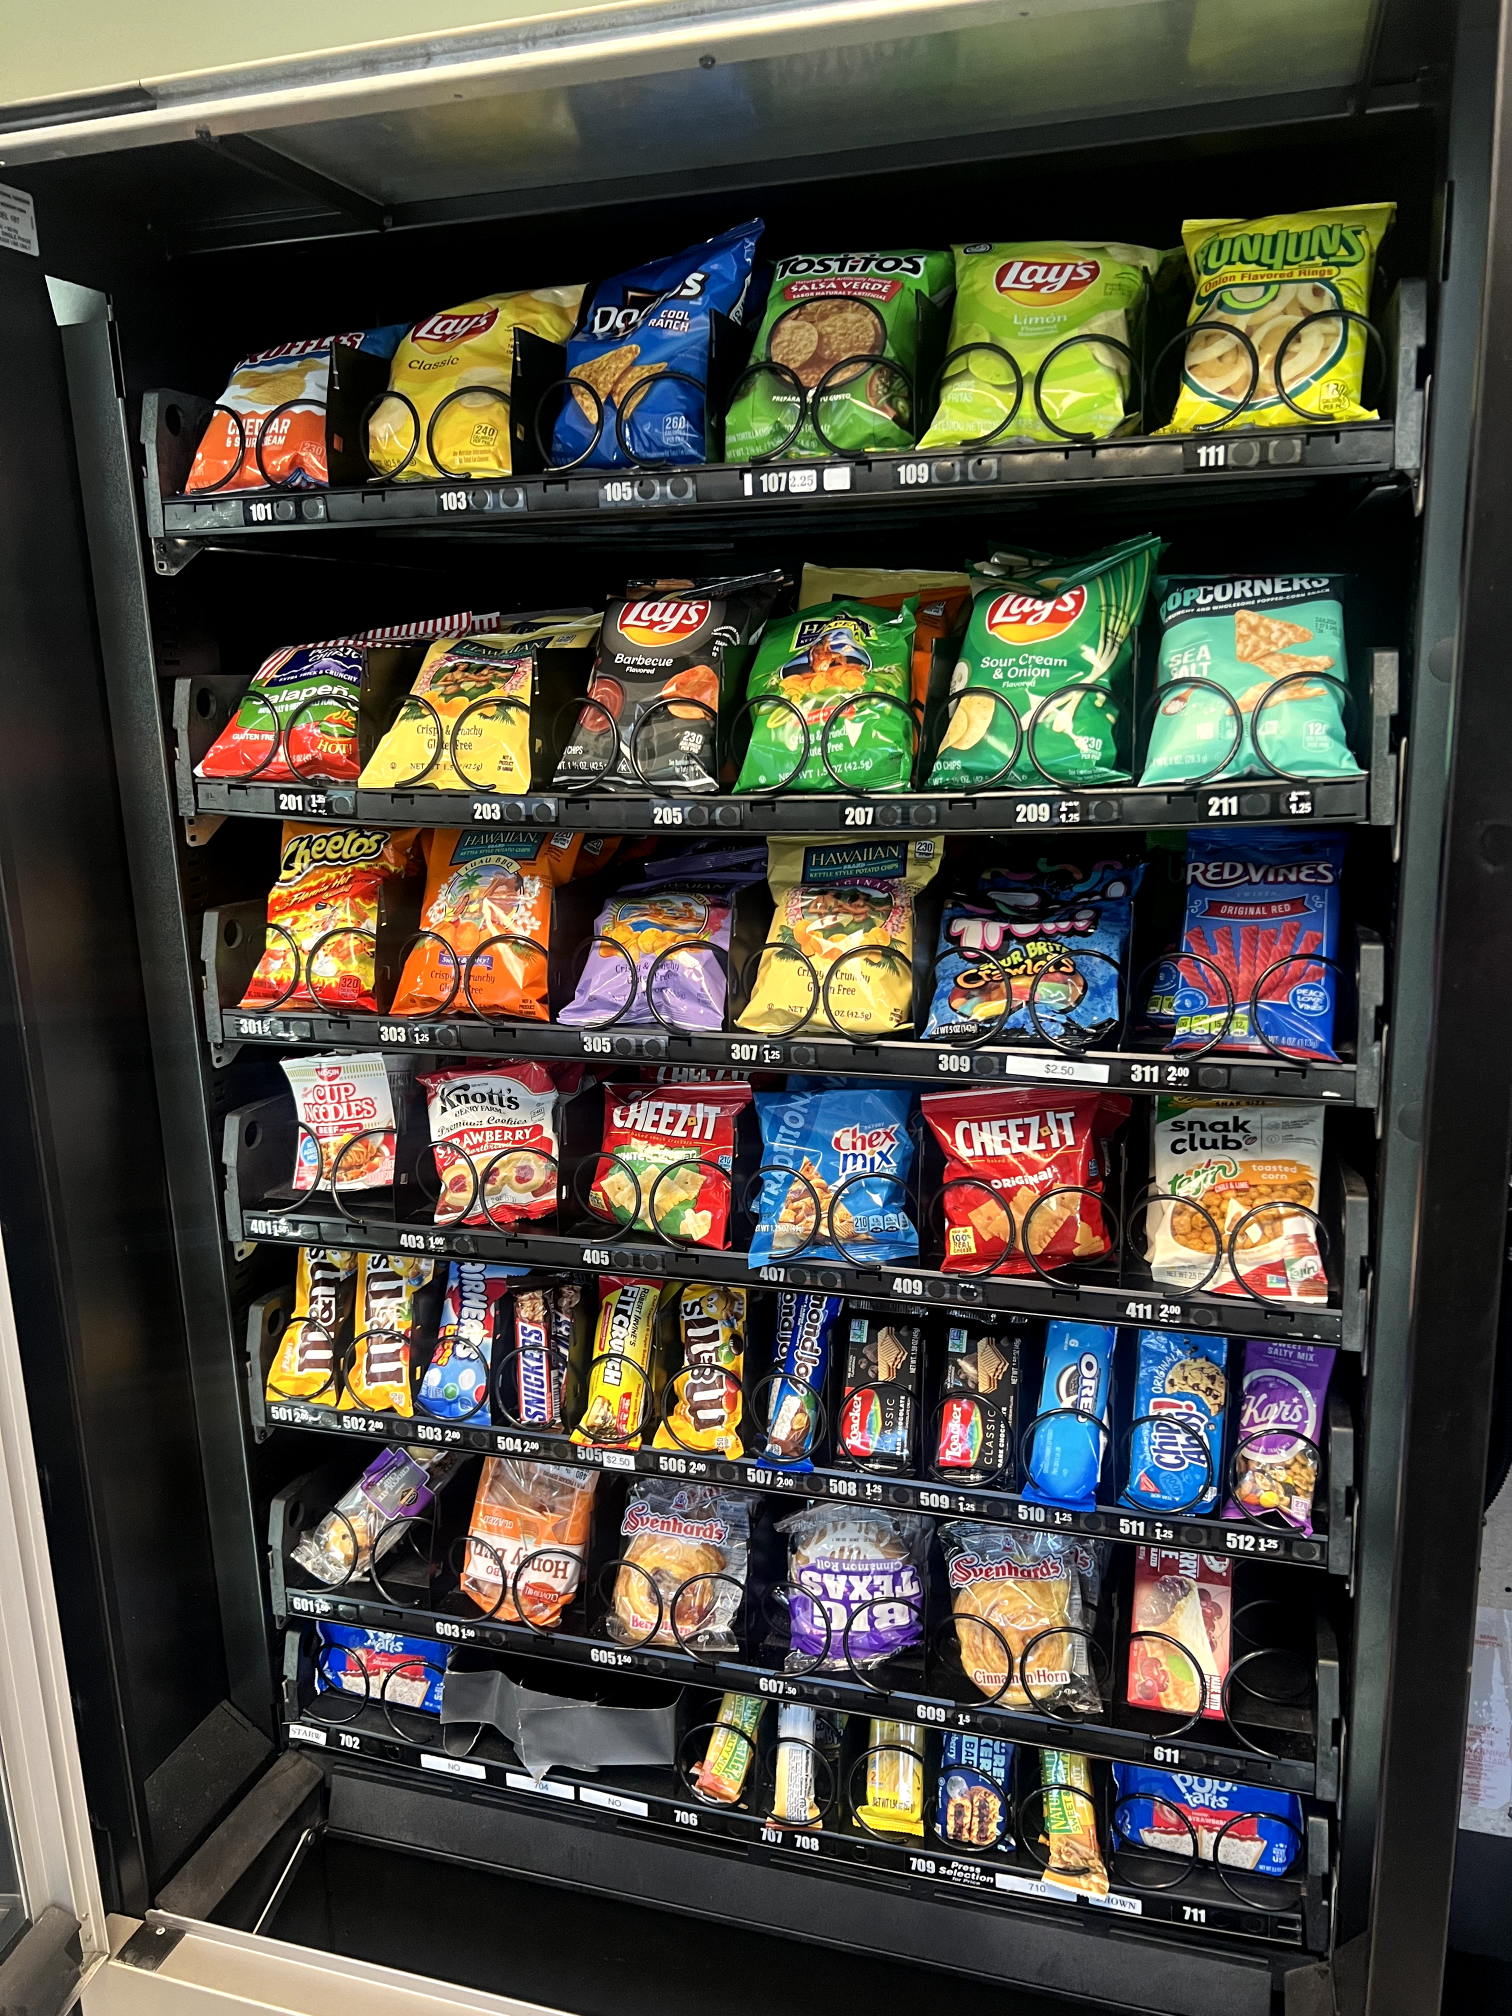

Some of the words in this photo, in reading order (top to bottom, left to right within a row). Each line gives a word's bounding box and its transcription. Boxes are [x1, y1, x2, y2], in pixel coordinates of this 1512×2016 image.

[1000, 261, 1096, 293] Lay's
[1205, 274, 1236, 293] Onion
[1240, 270, 1294, 281] Flavored
[1298, 267, 1333, 278] Rings
[791, 281, 836, 292] SALSA
[843, 281, 891, 292] VERDE
[660, 310, 690, 321] COOL
[1013, 313, 1067, 324] Limón
[416, 313, 492, 342] Lay's
[648, 318, 690, 332] RANCH
[408, 355, 459, 371] Classic
[475, 426, 495, 437] 240
[1197, 445, 1225, 467] 111
[898, 463, 929, 484] 109
[760, 473, 787, 492] 107
[789, 474, 814, 488] 2.25
[604, 482, 632, 501] 105
[440, 491, 467, 510] 103
[250, 503, 272, 521] 101
[614, 653, 673, 667] Barbecue
[981, 657, 1015, 668] Sour
[1019, 654, 1067, 667] Cream
[1169, 645, 1211, 667] SEA
[325, 669, 358, 682] CRUNCHY
[993, 669, 1004, 679] &
[1007, 666, 1050, 678] Onion
[682, 731, 703, 744] 230
[317, 739, 352, 754] HOT!
[280, 794, 303, 810] 201
[1208, 796, 1238, 816] 211
[1290, 803, 1312, 814] 1.25
[473, 803, 500, 820] 203
[653, 807, 682, 825] 205
[845, 807, 873, 825] 207
[1016, 804, 1050, 823] 209
[464, 832, 537, 846] HAWAIIAN
[916, 842, 933, 852] 230
[279, 829, 389, 881] Cheetos
[811, 845, 899, 866] HAWAIIAN
[464, 857, 492, 872] LUAU
[496, 857, 513, 869] BBQ
[881, 863, 898, 871] CHIPS
[1221, 905, 1267, 915] ORIGINAL
[1272, 904, 1291, 913] RED
[341, 978, 358, 988] 320
[837, 985, 856, 995] Free
[1296, 989, 1324, 997] PEACE
[1297, 1003, 1324, 1011] VINES
[240, 1019, 262, 1034] 301
[380, 1026, 406, 1042] 303
[583, 1037, 611, 1053] 305
[731, 1044, 757, 1060] 307
[938, 1055, 970, 1072] 309
[1044, 1065, 1074, 1076] $2.50
[1131, 1064, 1159, 1082] 311
[1167, 1066, 1189, 1082] 2.00
[313, 1083, 356, 1104] CUP
[440, 1083, 520, 1116] Knott's
[304, 1097, 376, 1124] NOODLES
[481, 1105, 502, 1113] FARM
[318, 1126, 339, 1134] BEEF
[437, 1119, 484, 1137] Premium
[487, 1116, 528, 1125] Cookies
[1169, 1116, 1252, 1133] snak
[832, 1123, 900, 1151] Chex
[1170, 1134, 1243, 1154] club
[840, 1144, 896, 1175] mix
[1251, 1164, 1298, 1173] toasted
[1215, 1184, 1228, 1193] CHILI
[250, 1220, 272, 1234] 401
[855, 1216, 868, 1228] 210
[400, 1234, 424, 1248] 403
[583, 1250, 609, 1265] 405
[760, 1267, 785, 1282] 407
[892, 1278, 922, 1295] 409
[635, 1288, 650, 1313] ROBERT
[1126, 1302, 1151, 1319] 411
[1159, 1305, 1180, 1317] 2.00
[1267, 1347, 1294, 1358] SALTY
[1297, 1352, 1315, 1362] MIX
[521, 1325, 546, 1423] SNICKERS
[271, 1407, 293, 1421] 501
[845, 1394, 863, 1450] Loacker
[343, 1416, 366, 1431] 502
[368, 1420, 383, 1431] 2.00
[882, 1398, 896, 1453] CLASSIC
[418, 1425, 442, 1441] 503
[445, 1429, 461, 1441] 2.00
[946, 1404, 962, 1462] Loacker
[984, 1410, 996, 1465] CLASSIC
[497, 1436, 522, 1452] 504
[523, 1440, 539, 1453] 2.00
[577, 1447, 602, 1462] 505
[606, 1455, 630, 1466] $2.50
[659, 1456, 686, 1473] 506
[689, 1461, 706, 1473] 2.00
[575, 1470, 588, 1481] 480
[747, 1468, 772, 1484] 507
[777, 1477, 793, 1487] 2.00
[829, 1479, 857, 1496] 508
[866, 1483, 882, 1495] 1.25
[920, 1492, 950, 1508] 509
[958, 1501, 975, 1512] 1.25
[484, 1515, 513, 1528] GLAZED
[1018, 1505, 1045, 1522] 510
[1054, 1511, 1072, 1524] 1.25
[622, 1502, 729, 1545] Svenhard's
[1119, 1519, 1145, 1536] 511
[1155, 1528, 1173, 1540] 1.25
[1227, 1533, 1255, 1552] 512
[1259, 1538, 1278, 1552] 1.25
[510, 1547, 570, 1579] Honey
[817, 1559, 840, 1571] Roll
[842, 1560, 903, 1572] Cinnamon
[951, 1554, 1064, 1586] Svenhard's
[800, 1571, 920, 1600] TEXAS
[293, 1597, 314, 1612] 601
[813, 1600, 911, 1632] BIG
[436, 1622, 460, 1638] 603
[461, 1628, 475, 1639] 1.50
[591, 1649, 617, 1664] 605
[617, 1654, 632, 1665] 1.50
[1037, 1670, 1068, 1683] Horn
[759, 1678, 784, 1693] 607
[917, 1705, 945, 1722] 609
[291, 1727, 322, 1740] STARW
[339, 1733, 360, 1750] 702
[1153, 1746, 1179, 1763] 611
[448, 1763, 461, 1772] NO
[714, 1755, 728, 1773] NUT
[608, 1797, 622, 1808] NO
[1185, 1791, 1229, 1809] tarts
[674, 1810, 698, 1826] 706
[1064, 1802, 1080, 1832] SWEET
[760, 1828, 782, 1843] 707
[795, 1835, 819, 1851] 708
[910, 1857, 935, 1873] 709
[951, 1861, 981, 1873] Press
[939, 1866, 993, 1884] Selection
[963, 1878, 980, 1886] Price
[1029, 1883, 1046, 1892] 710
[1183, 1906, 1206, 1923] 711
